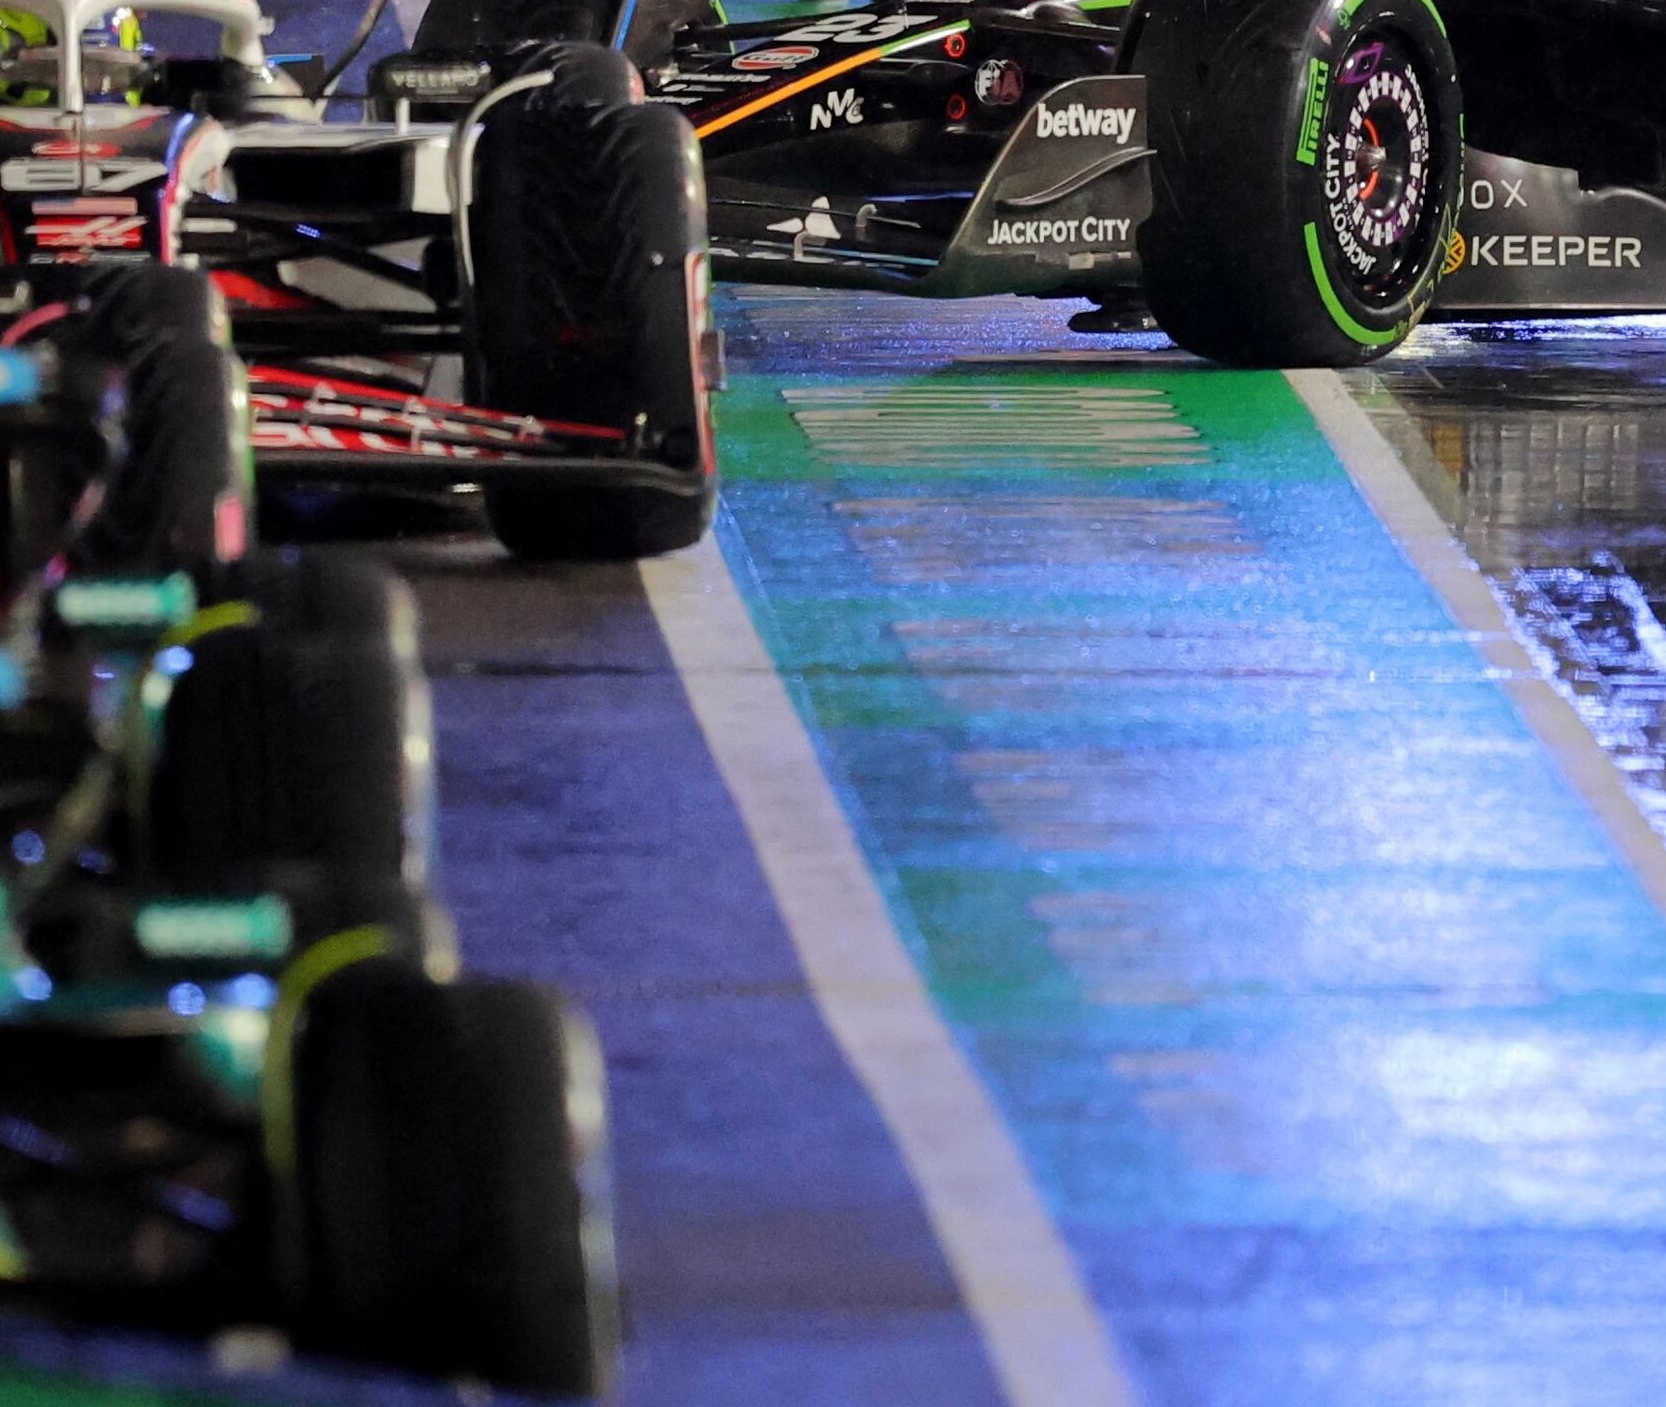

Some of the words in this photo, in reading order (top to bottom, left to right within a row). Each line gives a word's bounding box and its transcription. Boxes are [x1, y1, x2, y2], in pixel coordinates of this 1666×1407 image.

[773, 12, 938, 43] 23
[1036, 102, 1136, 144] betway
[1296, 57, 1329, 166] PIRELLI
[1325, 132, 1341, 199] CITY
[987, 219, 1079, 245] JACKPOT
[1082, 216, 1131, 242] CITY
[1330, 201, 1378, 275] JACKPOT
[1471, 235, 1641, 268] KEEPER
